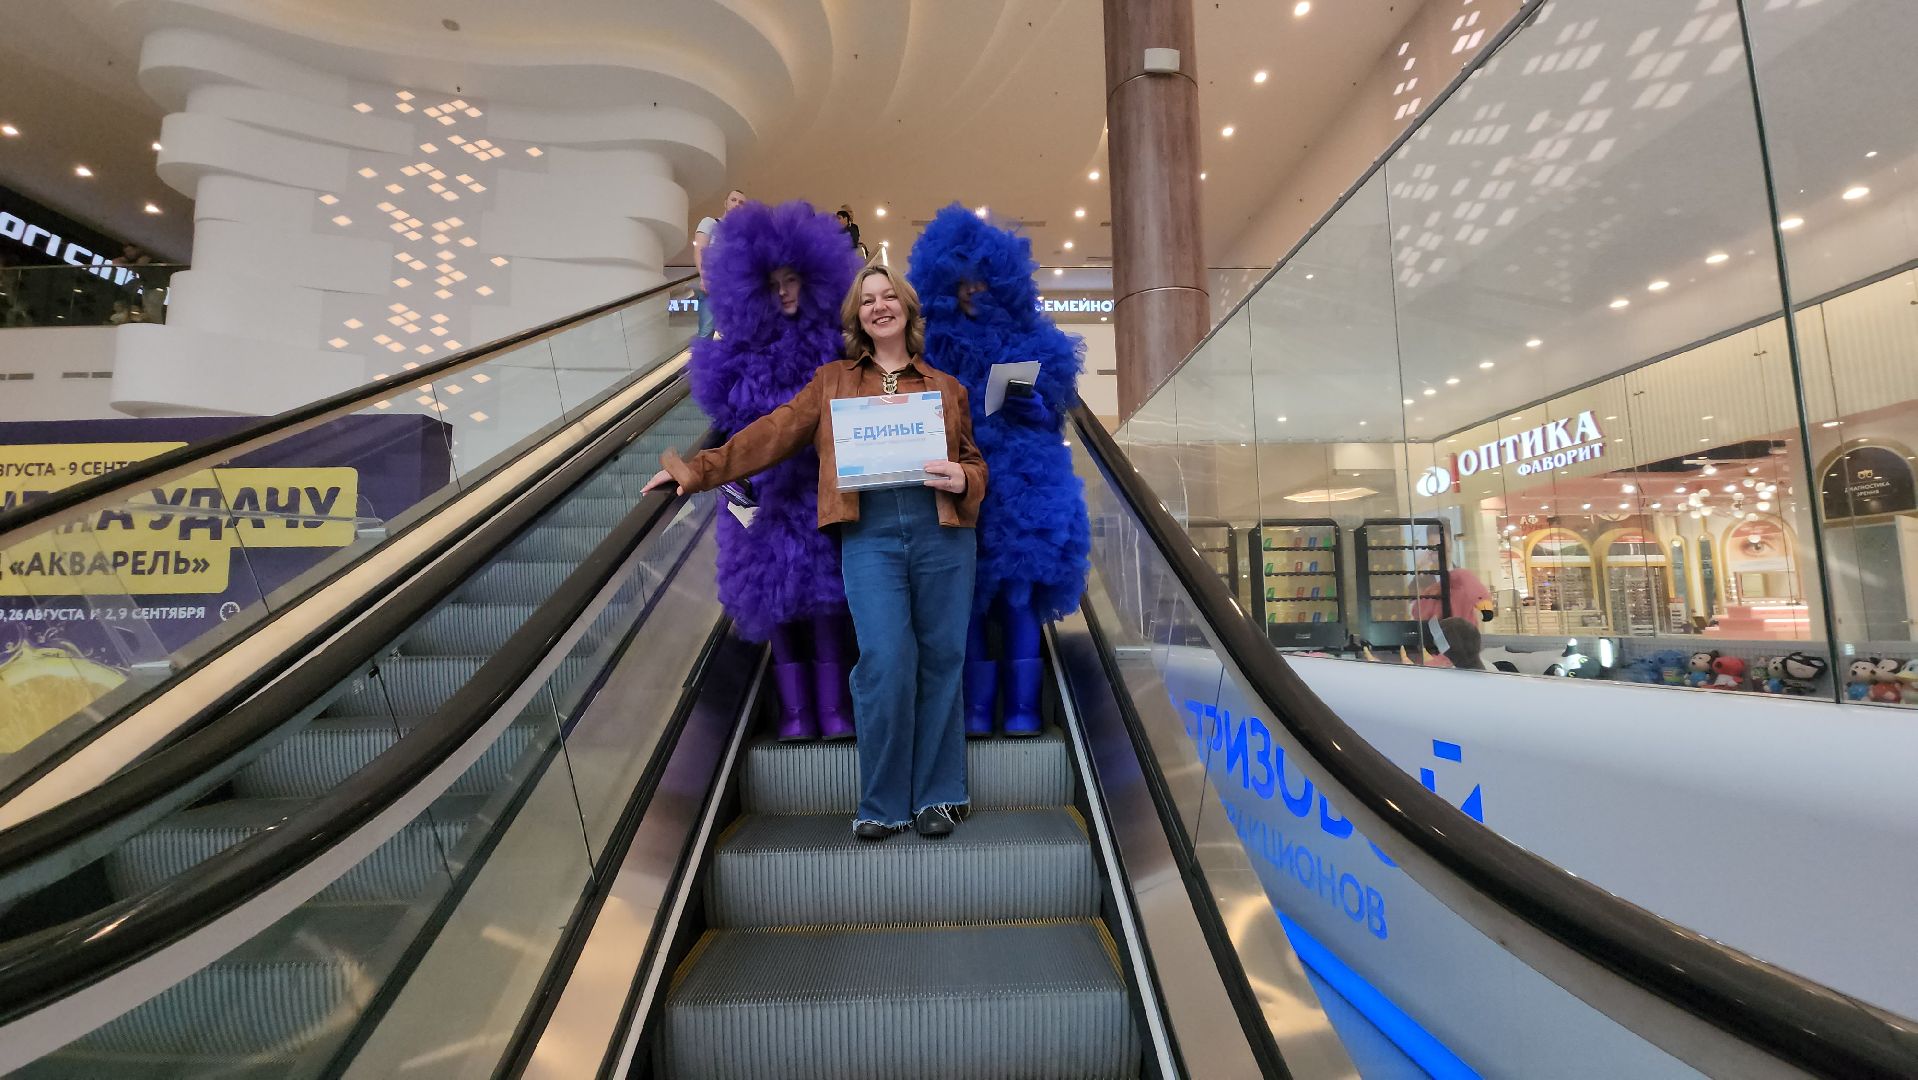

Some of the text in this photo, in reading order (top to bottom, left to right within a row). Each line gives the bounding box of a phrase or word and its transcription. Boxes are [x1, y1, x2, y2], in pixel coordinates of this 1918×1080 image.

[853, 421, 925, 441] ЕДИНЫЕ
[1457, 410, 1604, 476] ОПТИКА
[69, 461, 78, 476] 9
[1517, 442, 1604, 476] ФАВОРИТ
[149, 486, 342, 541] УДАЧУ
[9, 550, 211, 577] «АКВАРЕЛЬ»
[24, 607, 85, 621] АВГУСТА
[131, 606, 206, 621] СЕНТЯБРЯ
